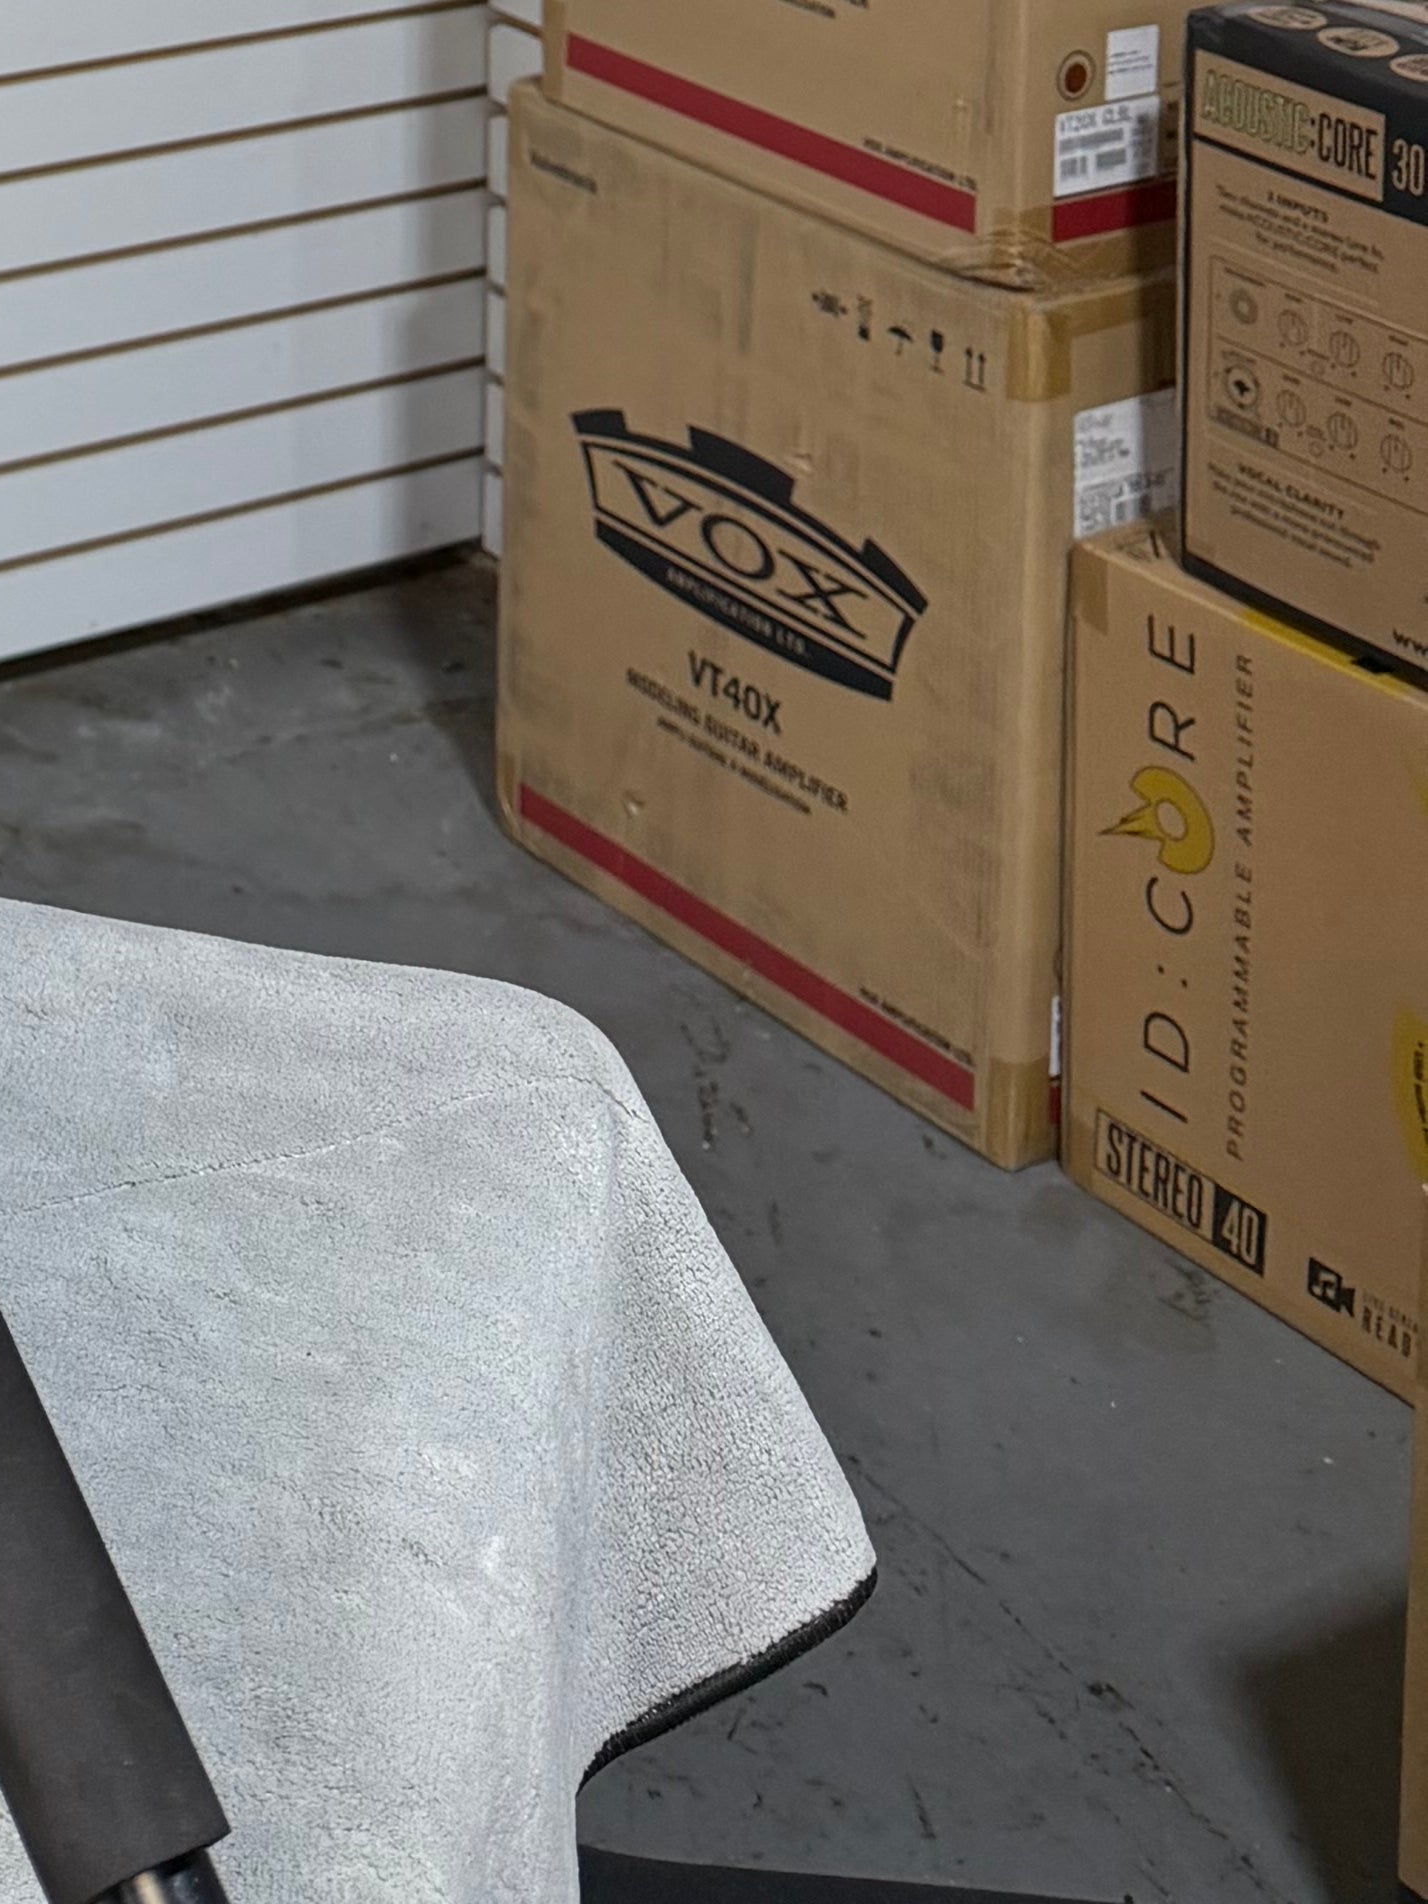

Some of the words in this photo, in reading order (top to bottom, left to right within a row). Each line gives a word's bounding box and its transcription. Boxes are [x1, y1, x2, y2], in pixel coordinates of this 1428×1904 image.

[1391, 138, 1425, 197] 30
[612, 460, 868, 640] VOX
[688, 649, 783, 737] VT40X
[763, 748, 849, 814] AMPLIFIER
[1234, 654, 1255, 848] AMPLIFIER
[1226, 862, 1253, 1161] PROGRAMMABLE
[1104, 1118, 1202, 1228] STEREO
[1220, 1199, 1259, 1261] 40
[1362, 1304, 1412, 1359] READ
